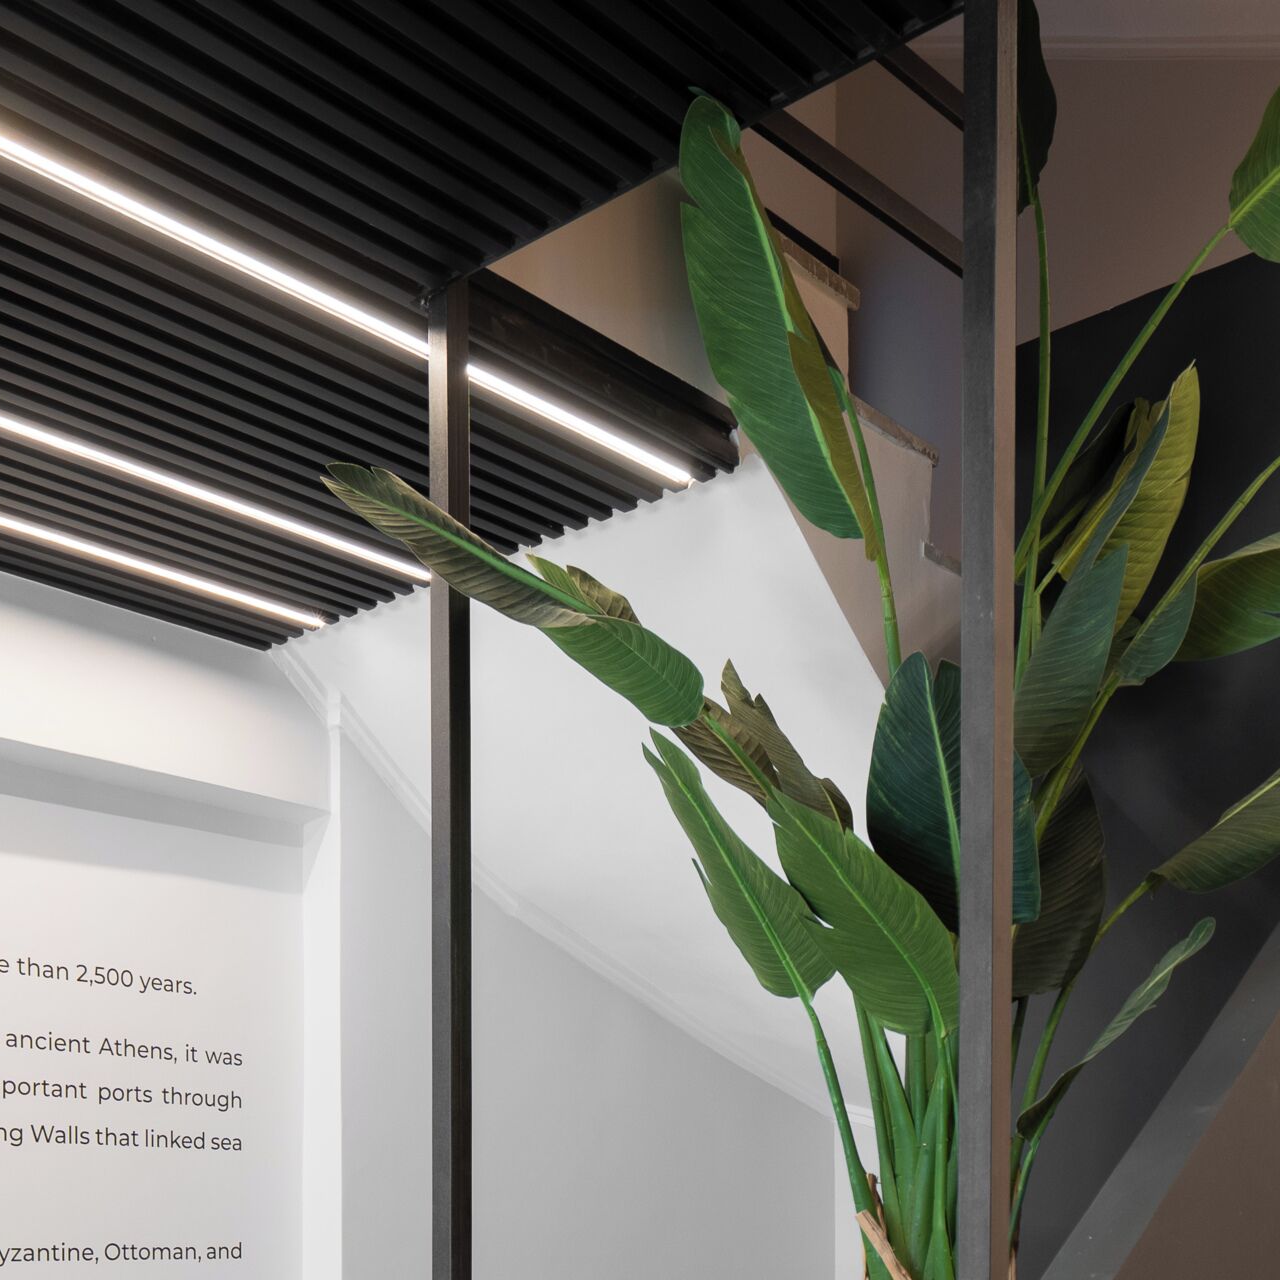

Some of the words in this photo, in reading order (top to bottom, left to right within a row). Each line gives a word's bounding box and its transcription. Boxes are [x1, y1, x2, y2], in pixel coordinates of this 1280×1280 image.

[16, 956, 69, 981] than
[75, 963, 134, 988] 2,500
[138, 975, 197, 996] years.
[5, 1031, 92, 1055] ancient
[97, 1037, 178, 1065] Athens,
[185, 1043, 199, 1063] it
[204, 1050, 243, 1067] was
[98, 1085, 153, 1105] ports
[161, 1086, 242, 1113] through
[29, 1123, 91, 1145] Walls
[94, 1126, 140, 1148] that
[145, 1128, 206, 1150] linked
[210, 1136, 242, 1152] sea
[103, 1242, 202, 1264] Ottoman,
[206, 1241, 243, 1260] and
